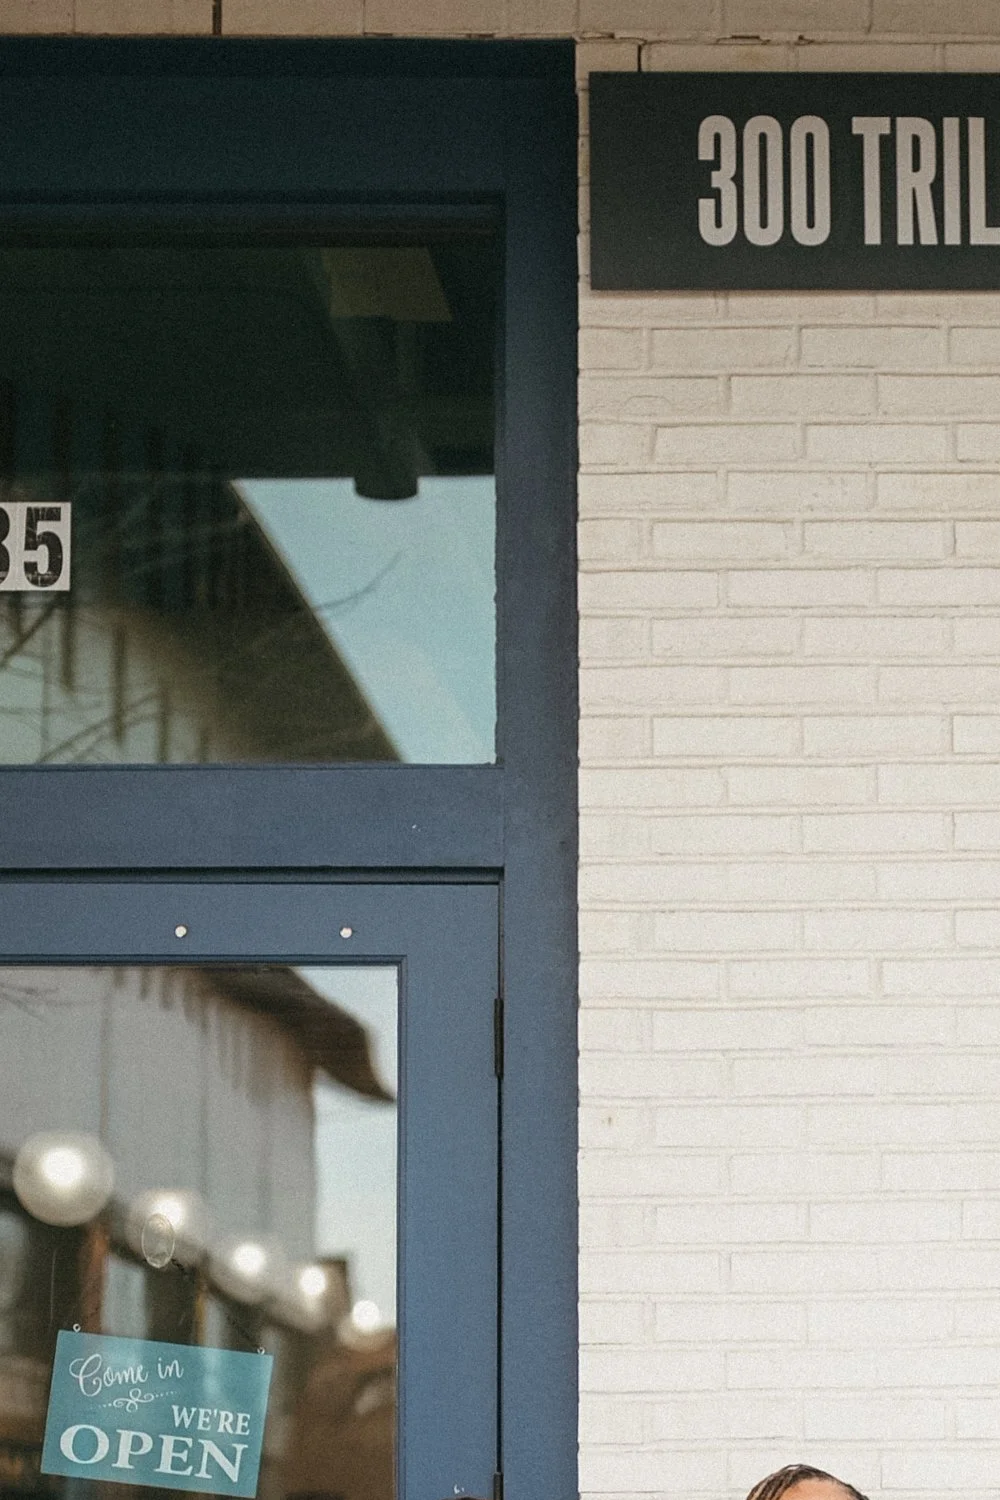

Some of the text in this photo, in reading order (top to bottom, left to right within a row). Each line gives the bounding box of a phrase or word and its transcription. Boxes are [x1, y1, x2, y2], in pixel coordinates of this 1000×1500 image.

[697, 114, 831, 246] 300
[0, 506, 63, 588] 5
[69, 1353, 184, 1397] Come in
[171, 1404, 251, 1436] WE'RE
[59, 1423, 248, 1483] OPEN
